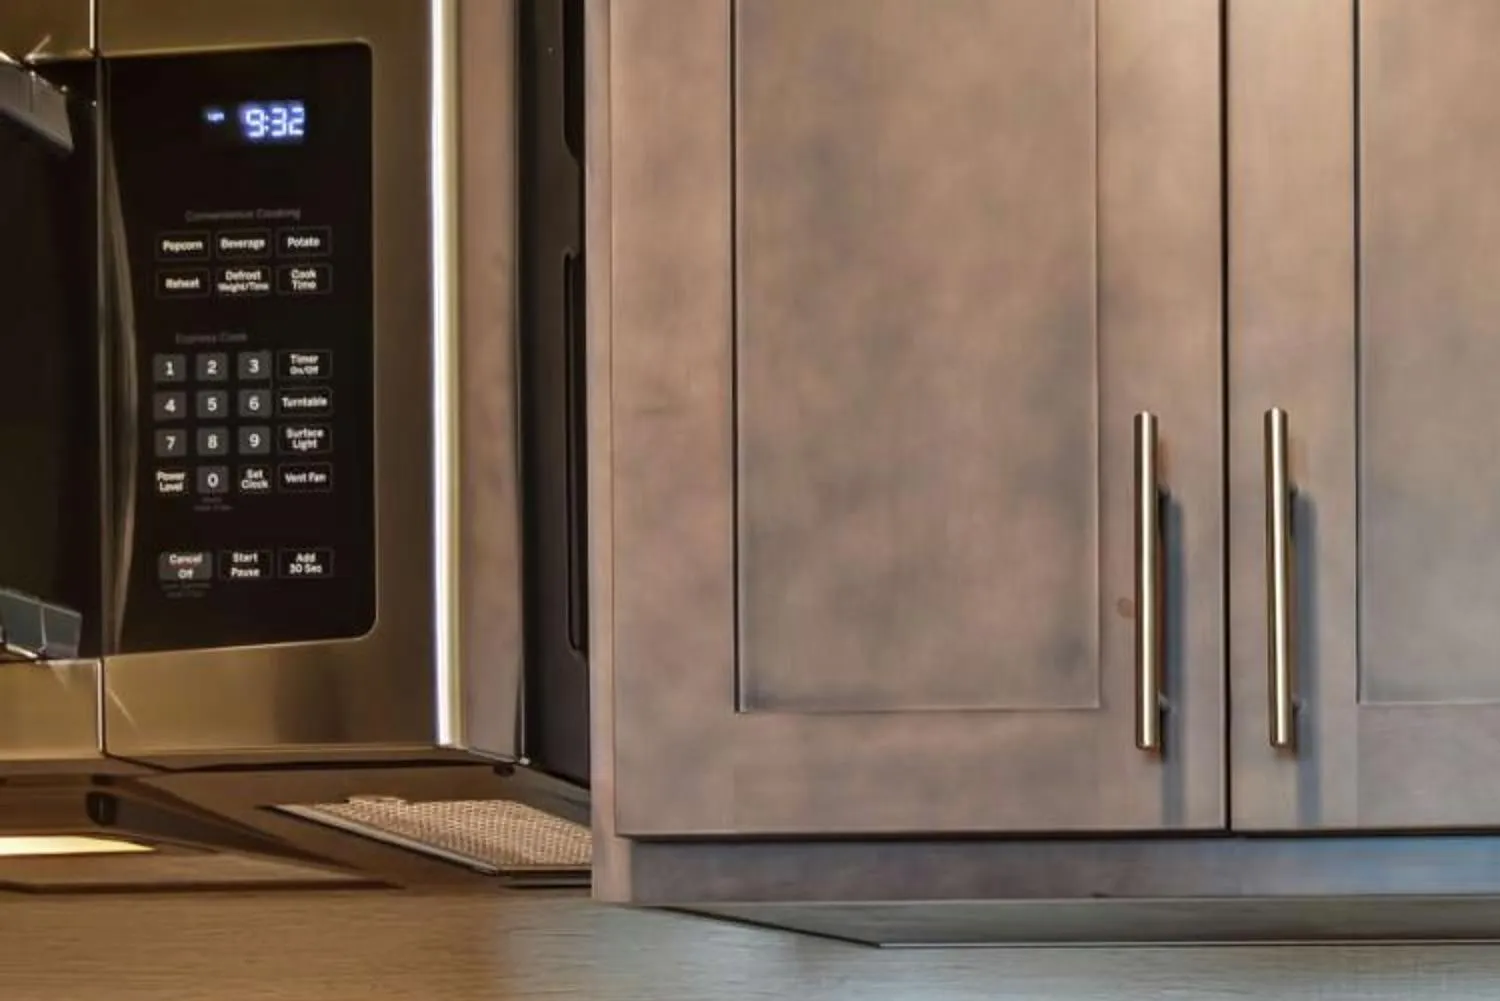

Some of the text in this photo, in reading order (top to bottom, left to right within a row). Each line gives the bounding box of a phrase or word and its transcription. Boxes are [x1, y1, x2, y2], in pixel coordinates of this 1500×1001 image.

[245, 107, 304, 137] 9:32
[163, 240, 203, 252] Popcorn
[220, 238, 265, 250] Beverage
[287, 236, 320, 247] Potato
[225, 270, 261, 281] Defrost
[291, 269, 316, 280] Cook
[165, 278, 200, 289] Reheat
[291, 280, 316, 290] Time
[290, 354, 319, 365] Timer
[165, 362, 174, 375] 1
[208, 361, 217, 374] 2
[249, 359, 260, 373] 3
[165, 399, 176, 412] 4
[208, 398, 217, 411] 5
[249, 397, 259, 410] 6
[282, 397, 328, 407] Turntable
[286, 428, 324, 439] Surface
[166, 437, 176, 450] 7
[208, 435, 218, 449] 8
[249, 434, 260, 447] 9
[292, 439, 318, 451] Light
[156, 471, 186, 482] Power
[247, 469, 263, 479] Set
[285, 472, 327, 483] Vent Fan
[208, 473, 218, 488] 0
[241, 479, 268, 489] Clock
[159, 481, 183, 492] Level
[169, 553, 202, 564] Cancel
[232, 553, 258, 563] Start
[296, 553, 315, 562] Add
[231, 567, 260, 577] Pause
[290, 564, 302, 574] 30
